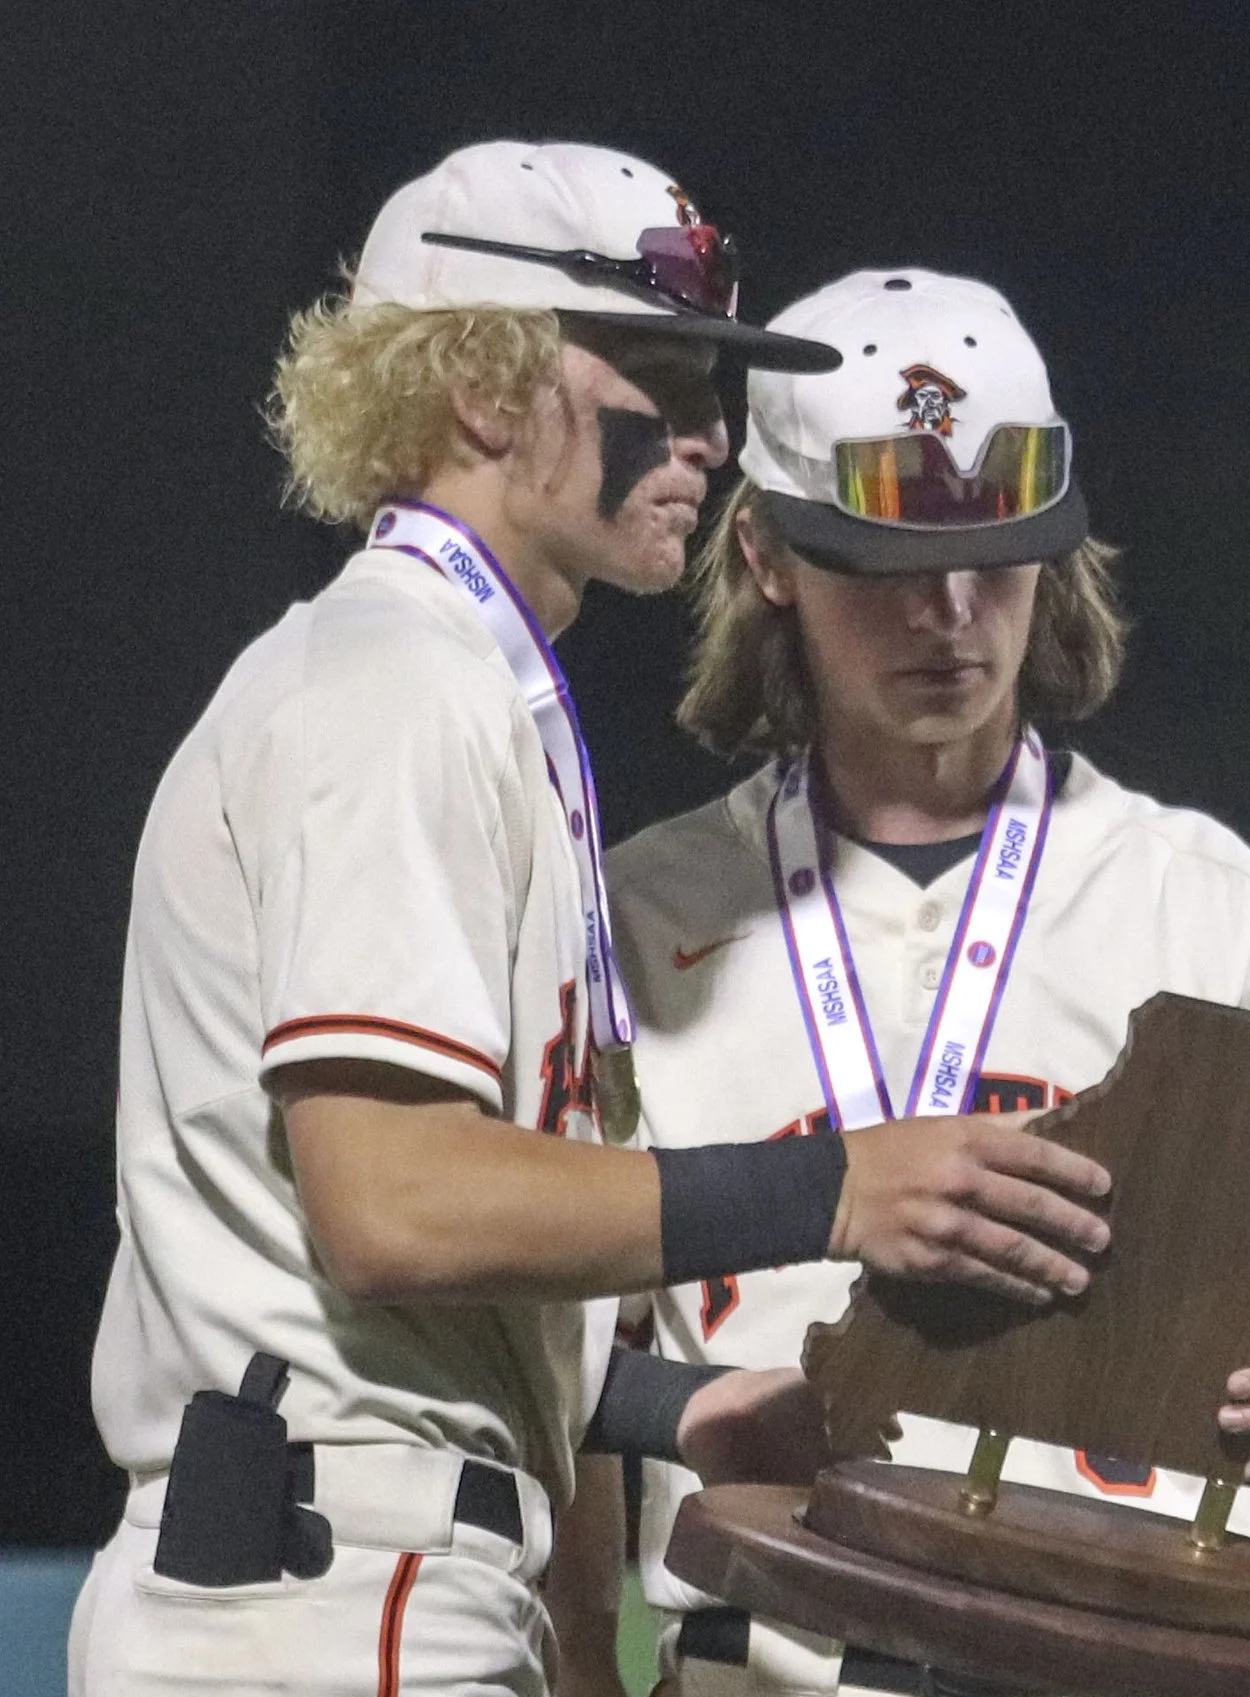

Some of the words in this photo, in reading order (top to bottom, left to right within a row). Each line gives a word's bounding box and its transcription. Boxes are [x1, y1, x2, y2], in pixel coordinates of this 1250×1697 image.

[439, 537, 495, 604] MSHSAA
[994, 817, 1029, 881] MSHSAA
[813, 956, 849, 1028] MSHSAA
[928, 1040, 967, 1110] MSHSAA
